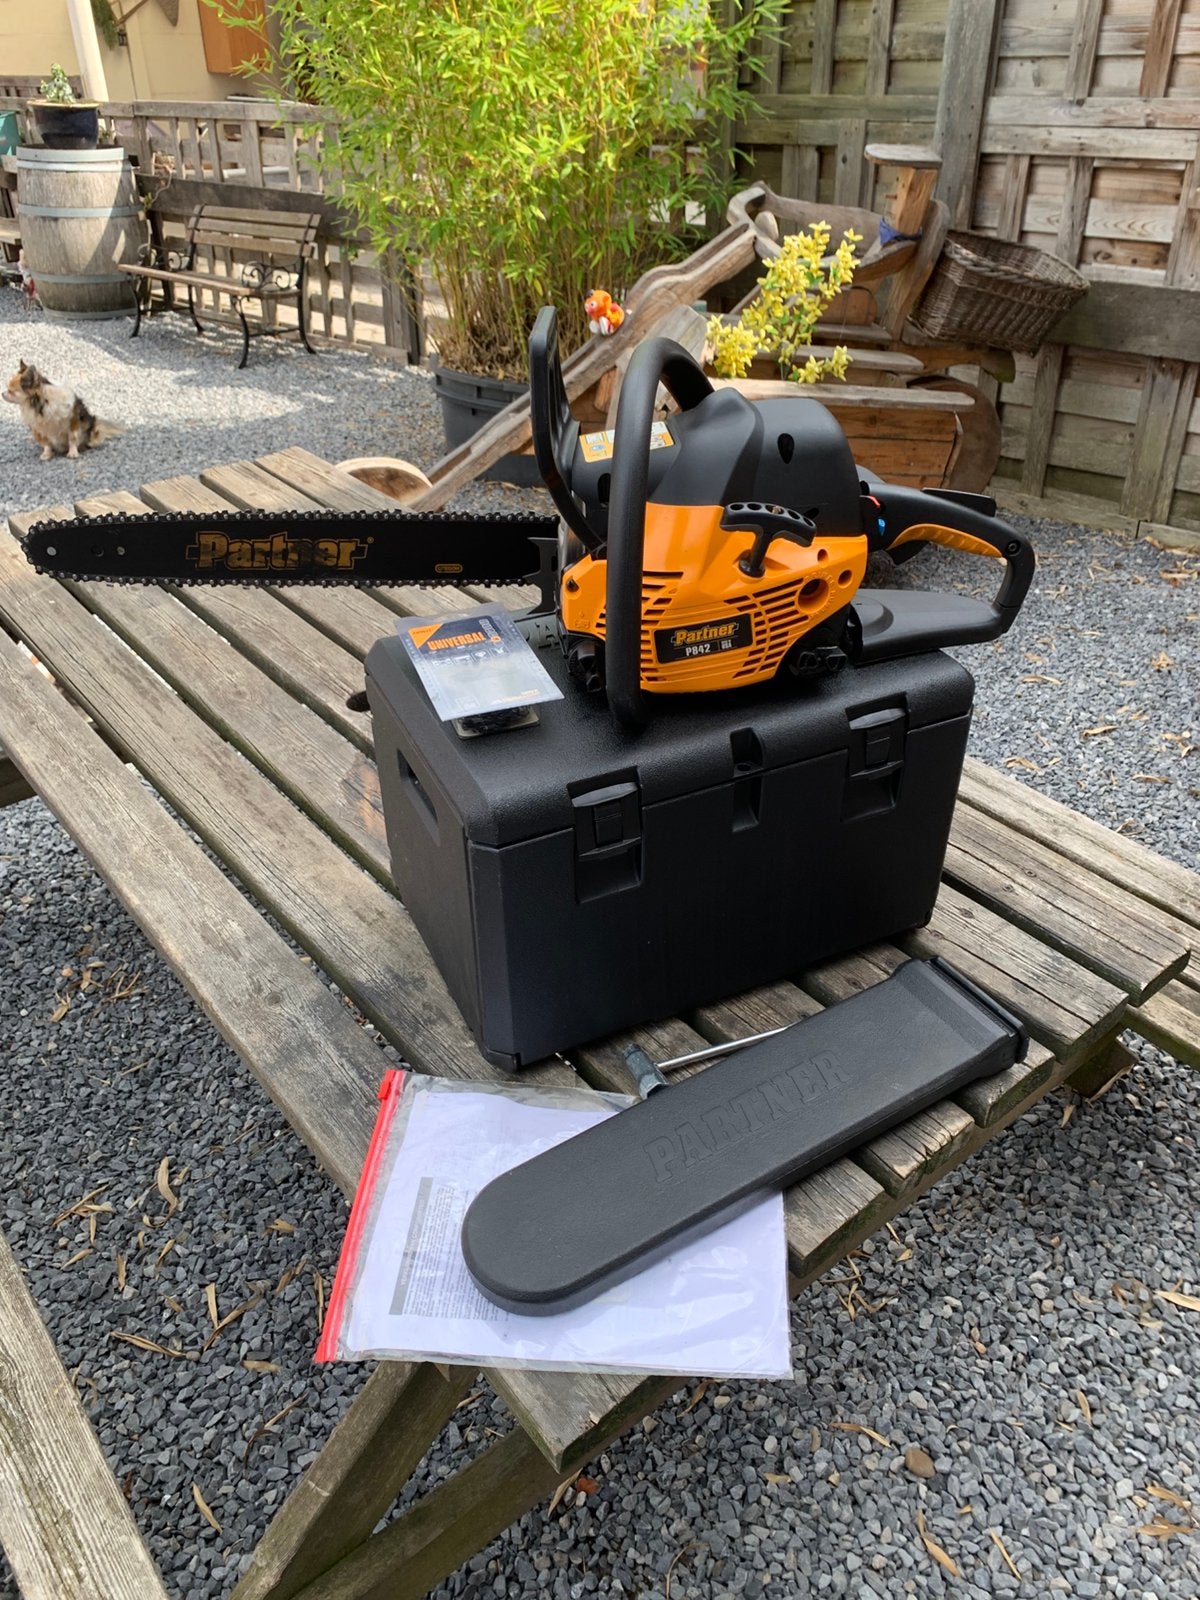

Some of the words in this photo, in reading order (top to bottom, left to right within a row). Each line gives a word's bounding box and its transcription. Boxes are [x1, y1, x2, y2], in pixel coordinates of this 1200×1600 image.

[427, 631, 487, 651] UNIVERSAL
[674, 622, 737, 646] Partner
[685, 643, 711, 657] P842
[643, 1049, 852, 1183] PARTNER
